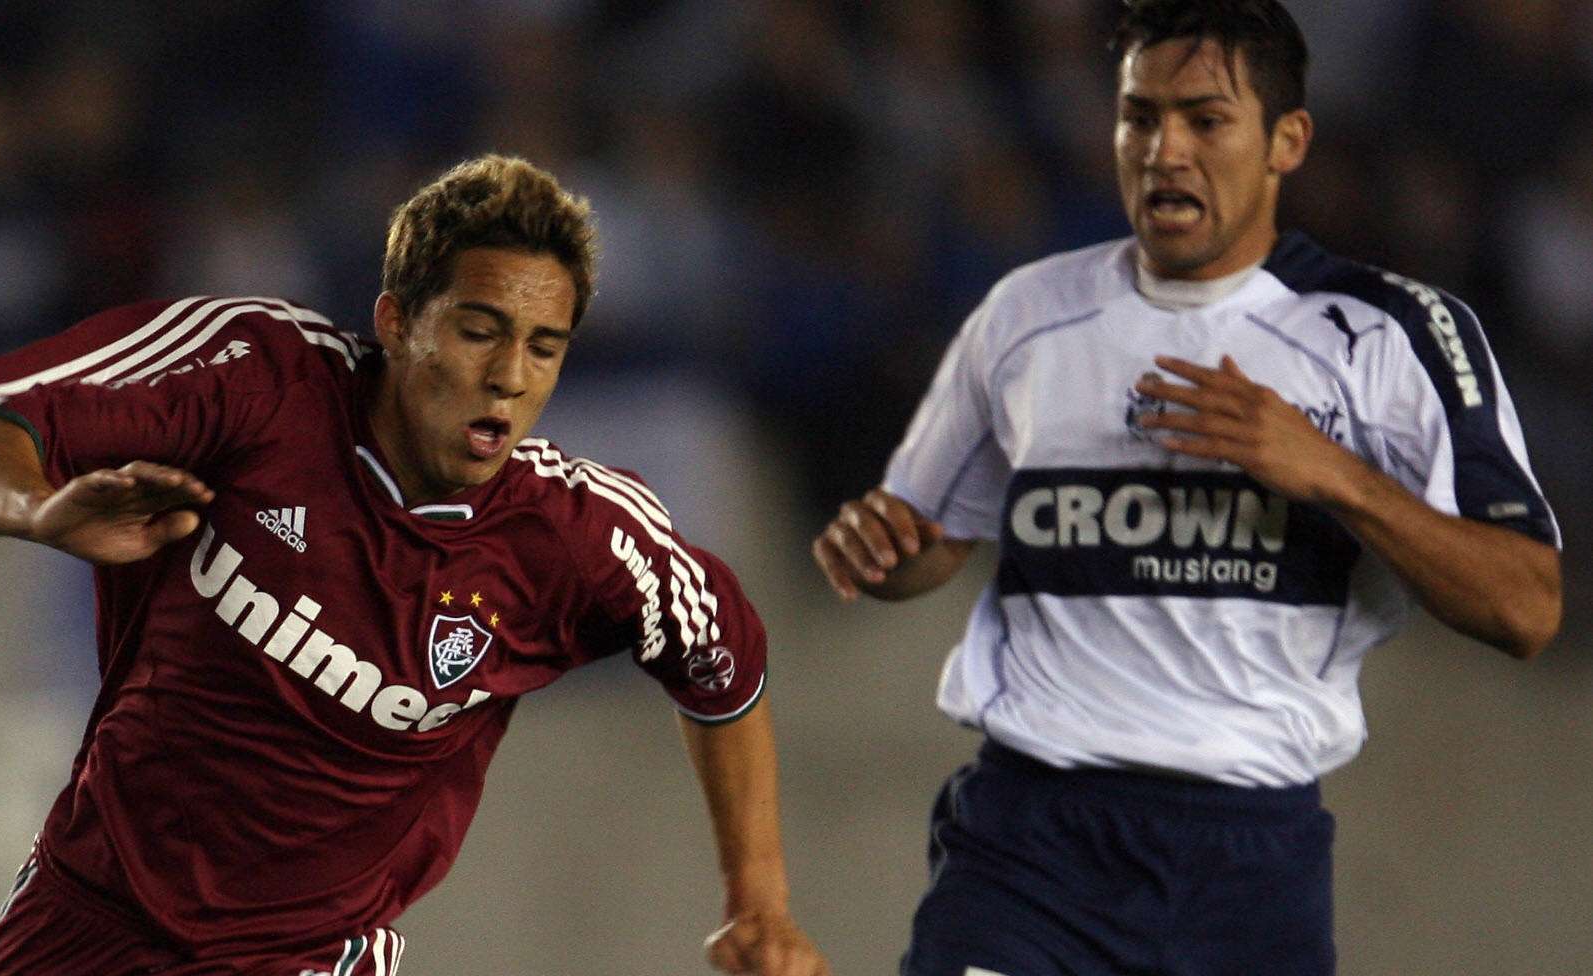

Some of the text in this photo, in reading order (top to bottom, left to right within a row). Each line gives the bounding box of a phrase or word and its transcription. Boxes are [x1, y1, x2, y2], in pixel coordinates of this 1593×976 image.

[256, 511, 307, 553] adidas
[1010, 484, 1288, 552] CROWN
[1133, 553, 1278, 592] mustang
